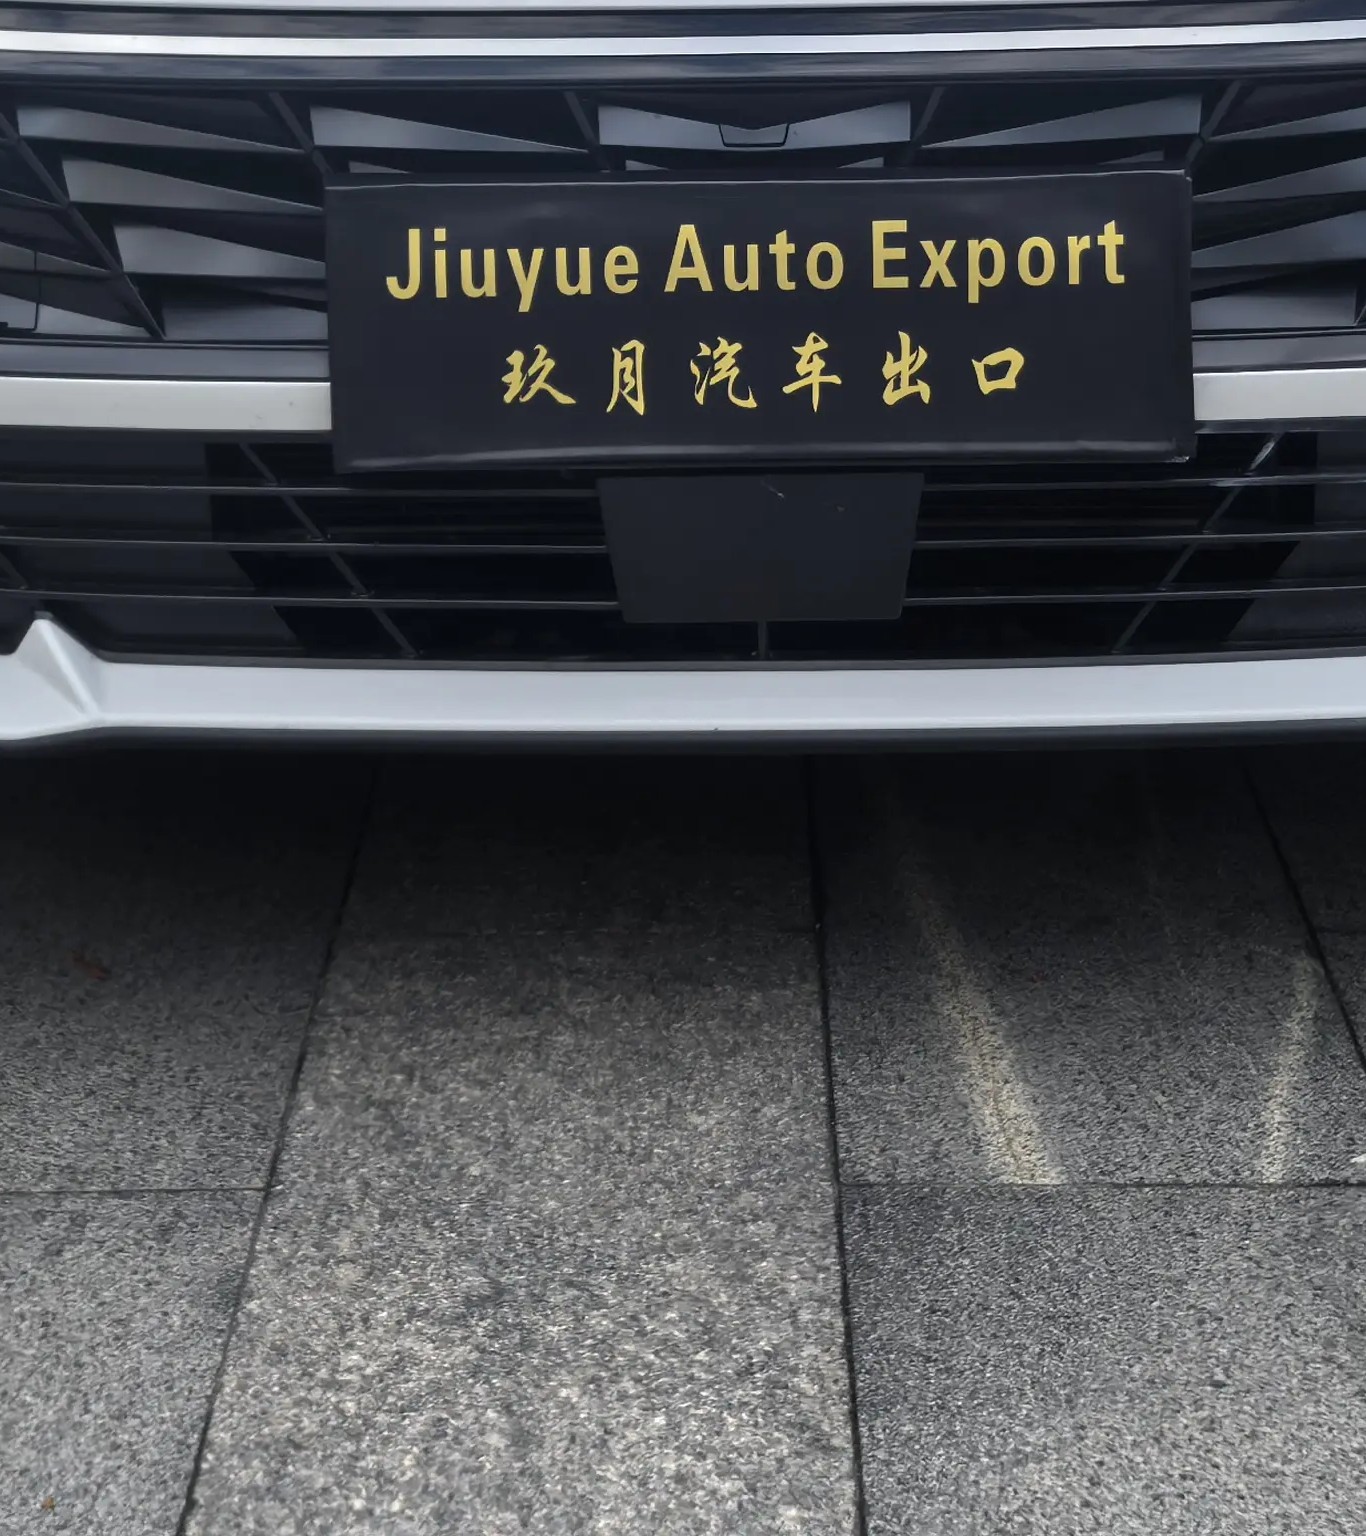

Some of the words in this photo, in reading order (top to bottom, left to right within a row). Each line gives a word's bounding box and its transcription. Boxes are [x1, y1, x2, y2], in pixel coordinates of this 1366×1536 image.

[385, 226, 641, 314] Jiuyue
[664, 223, 847, 294] Auto
[871, 218, 1127, 305] Export
[500, 331, 1026, 417] 玖月汽车出口
